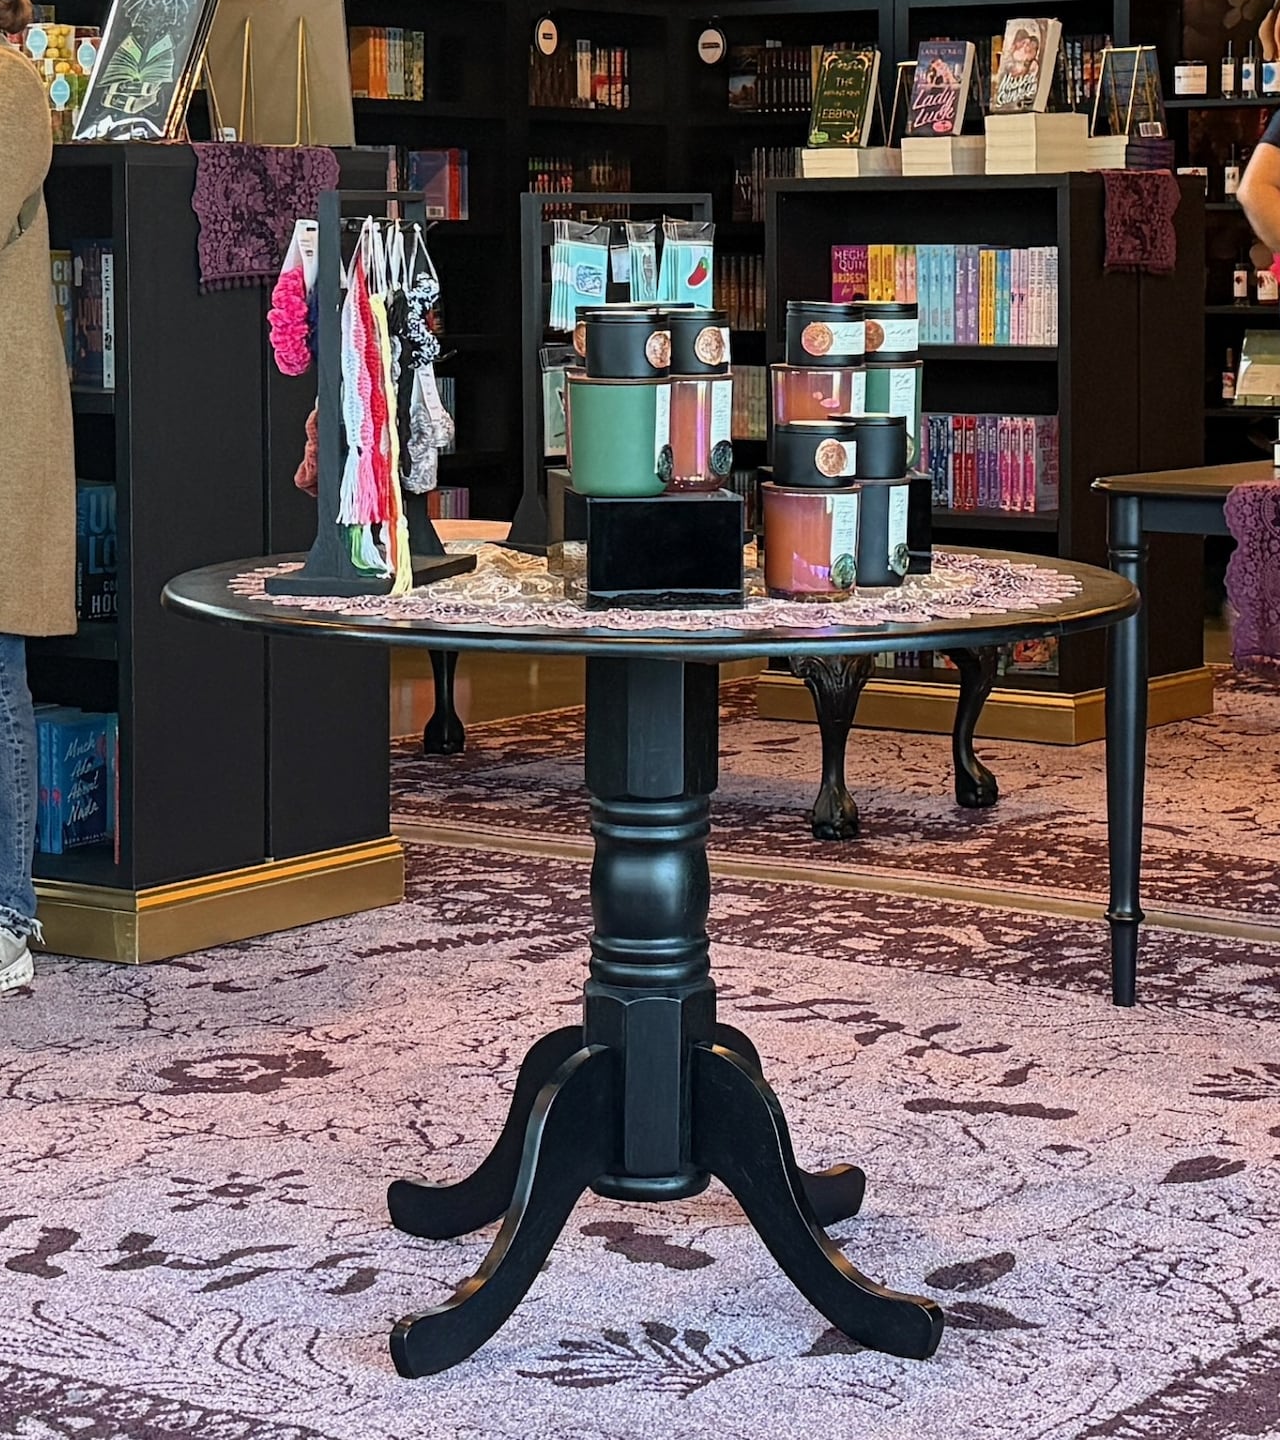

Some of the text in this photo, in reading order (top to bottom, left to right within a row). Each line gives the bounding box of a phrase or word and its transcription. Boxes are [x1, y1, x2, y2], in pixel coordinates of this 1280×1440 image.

[912, 85, 956, 112] Lady
[913, 105, 955, 128] Luck
[64, 731, 96, 762] Much
[71, 759, 92, 778] Ado
[68, 771, 99, 803] About
[67, 802, 100, 826] Nada
